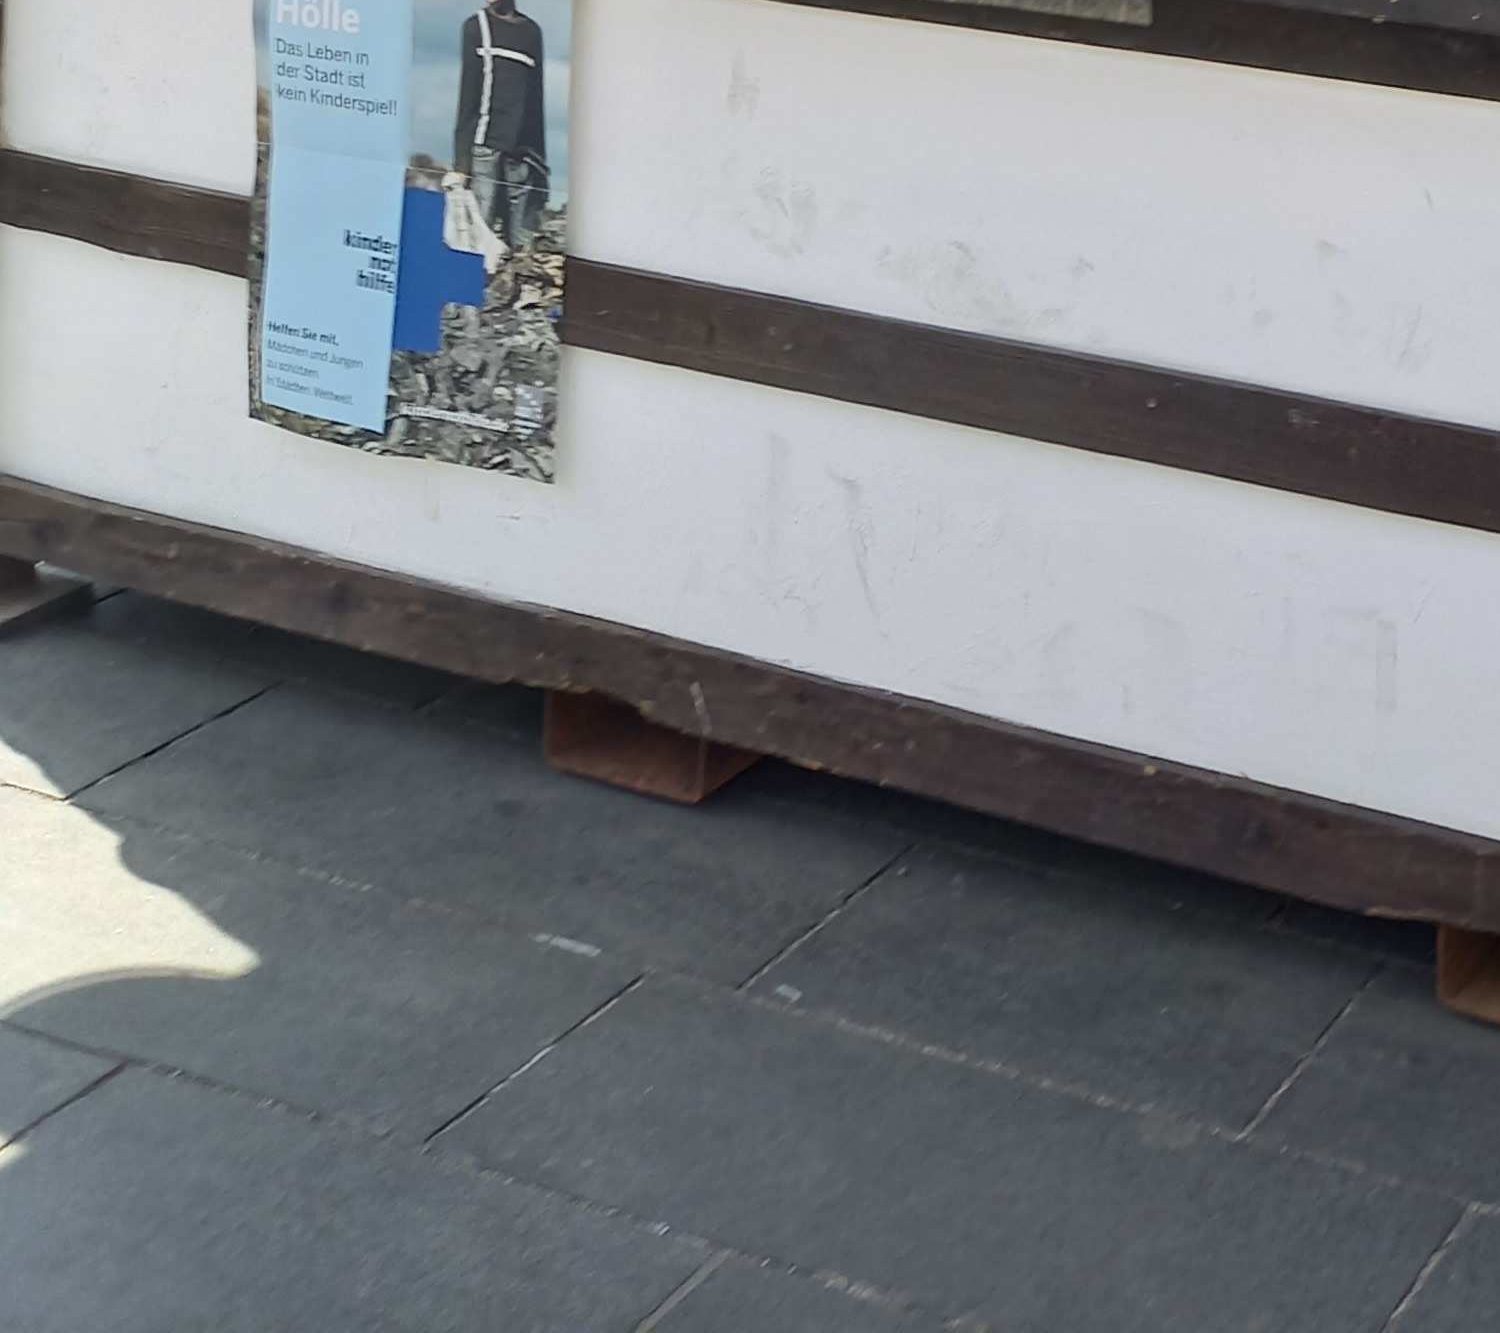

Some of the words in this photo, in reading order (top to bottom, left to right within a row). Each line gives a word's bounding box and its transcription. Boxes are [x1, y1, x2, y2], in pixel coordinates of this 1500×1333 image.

[276, 37, 304, 58] Das
[307, 41, 352, 64] Leben
[355, 50, 370, 67] in
[276, 62, 301, 79] der
[304, 64, 345, 87] Stadt
[347, 71, 367, 90] ist
[276, 83, 308, 104] kein
[310, 88, 399, 118] Kinderspiel!
